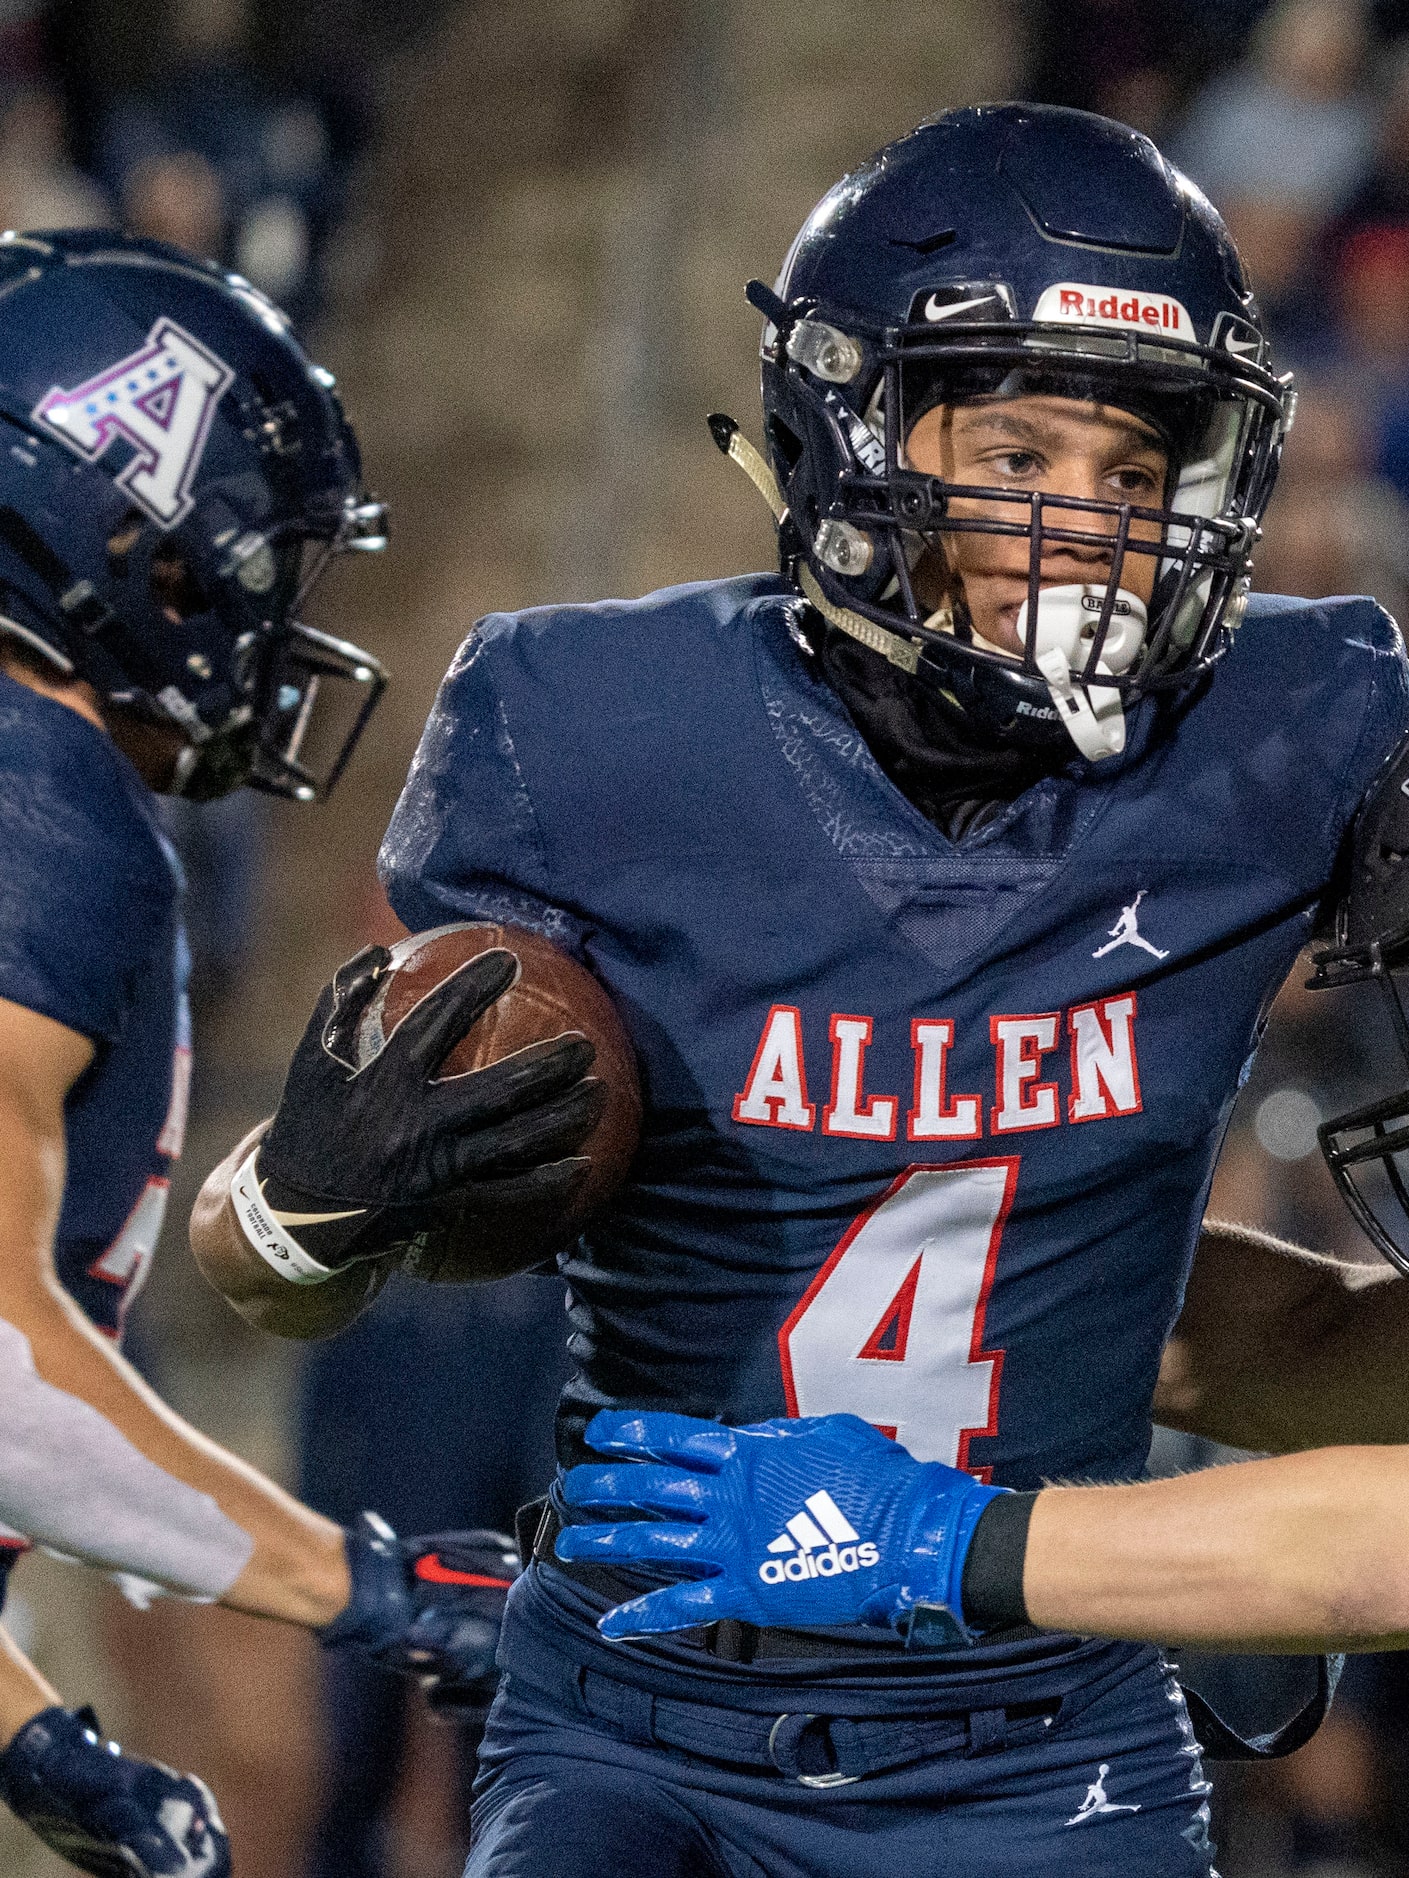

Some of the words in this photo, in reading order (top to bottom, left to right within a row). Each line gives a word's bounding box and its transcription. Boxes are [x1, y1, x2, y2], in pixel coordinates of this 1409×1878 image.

[1059, 289, 1180, 330] Riddell
[31, 316, 237, 531] A
[732, 990, 1143, 1142] ALLEN
[778, 1155, 1021, 1485] 4
[758, 1541, 881, 1585] adidas
